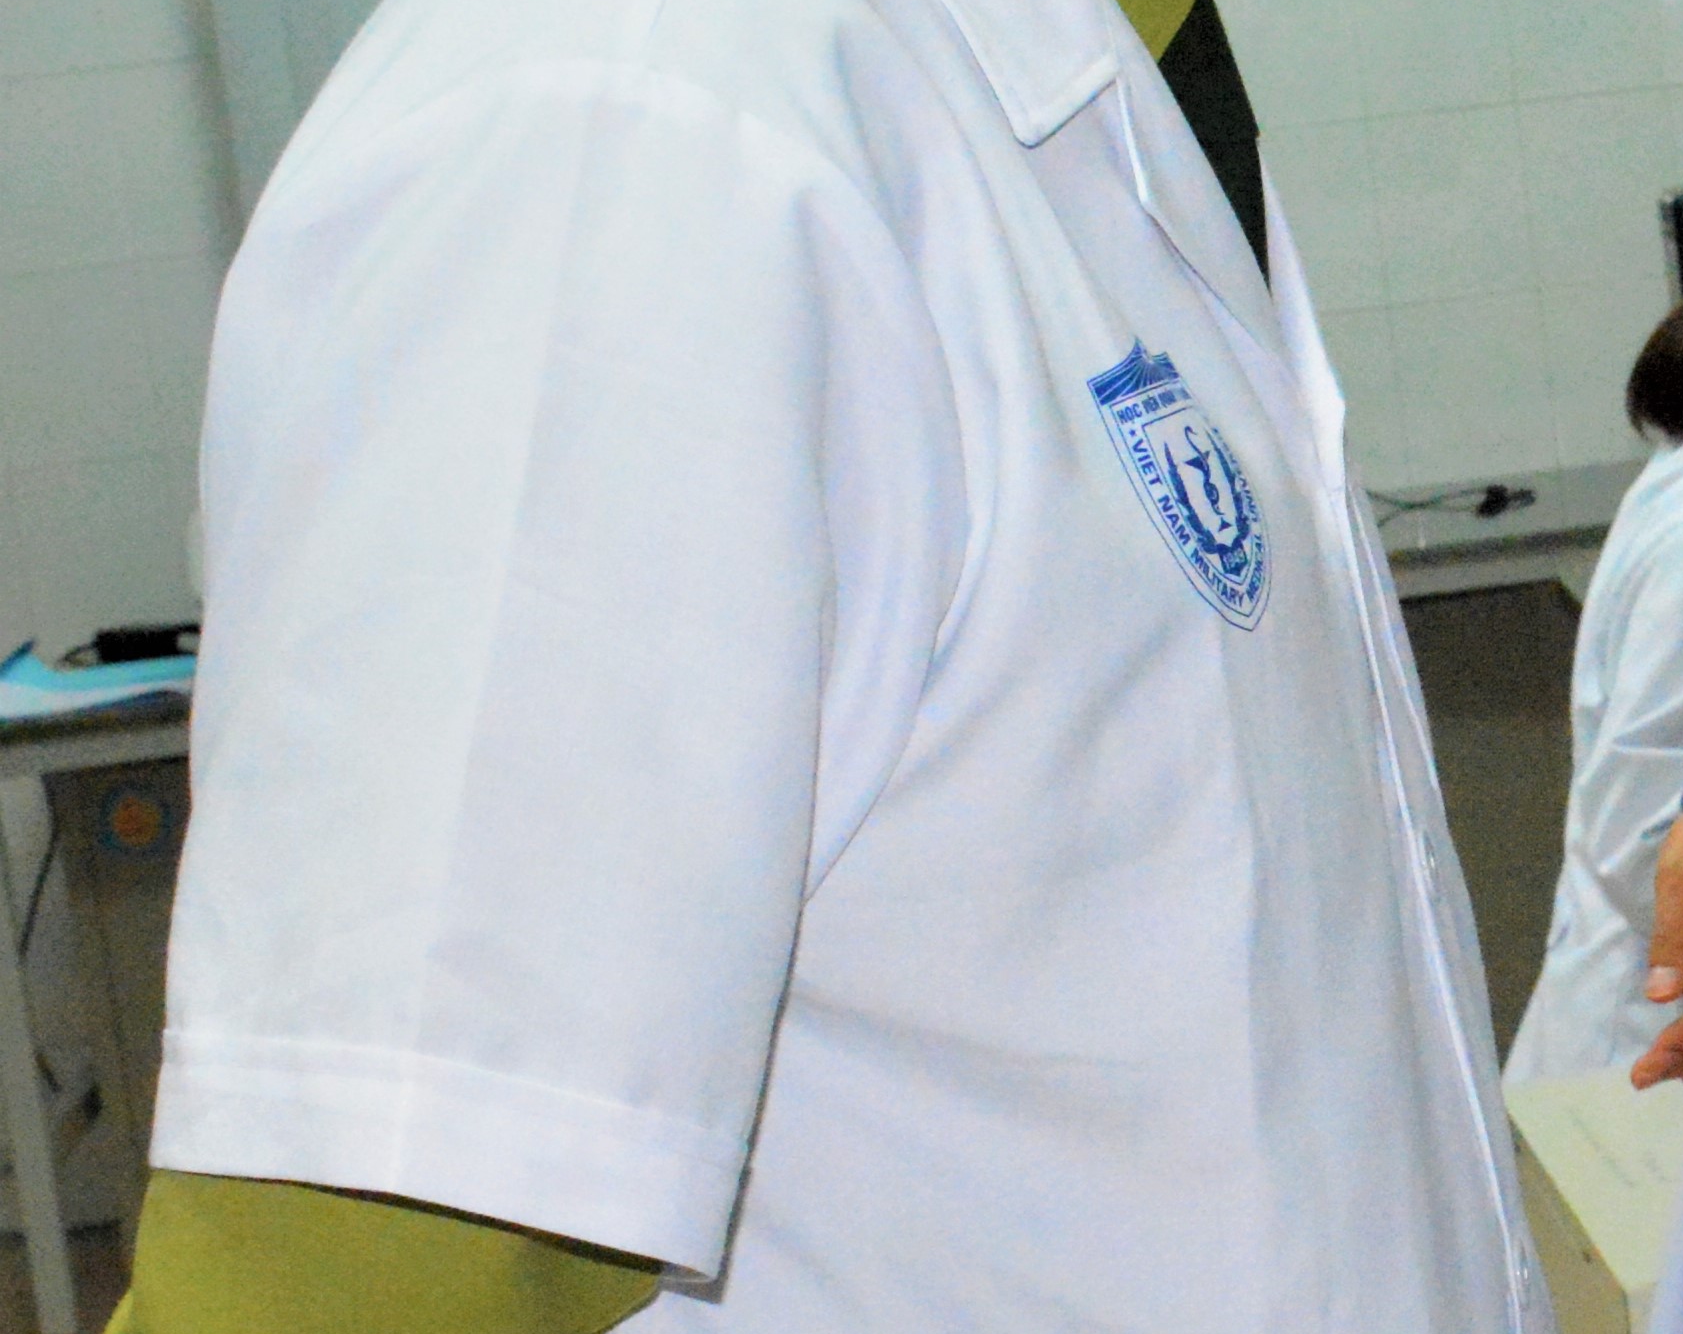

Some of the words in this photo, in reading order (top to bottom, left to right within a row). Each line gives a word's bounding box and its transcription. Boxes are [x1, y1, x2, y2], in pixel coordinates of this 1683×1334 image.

[1131, 438, 1163, 486] VIET
[1157, 494, 1191, 546] NAM
[1190, 547, 1245, 608] MILITARY
